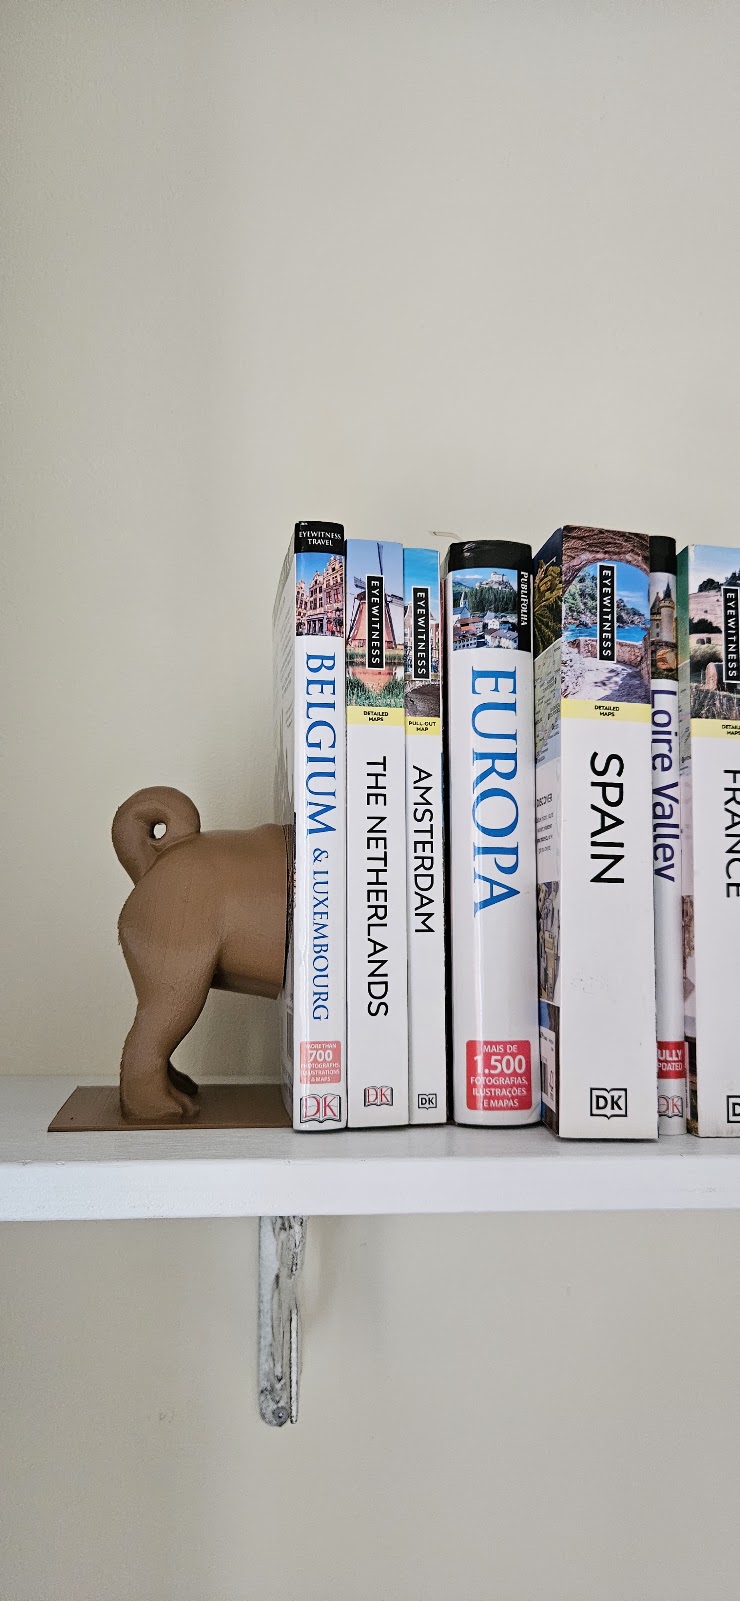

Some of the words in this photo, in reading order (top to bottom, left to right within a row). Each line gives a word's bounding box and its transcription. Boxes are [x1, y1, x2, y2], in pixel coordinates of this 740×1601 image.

[299, 531, 341, 539] EYEWITNESS
[520, 571, 529, 626] PUBLIFOLHA
[371, 581, 380, 664] EYEWITNESS
[603, 570, 611, 656] EYEWITNESS
[417, 592, 426, 675] EYEWITNESS
[726, 592, 737, 677] EYEWITNESS
[651, 690, 677, 772] Loire
[305, 652, 336, 836] BELGIUM
[366, 755, 387, 807] THE
[471, 666, 520, 918] EUROPA
[589, 751, 625, 884] SPAIN
[312, 848, 329, 862] &
[412, 764, 436, 933] AMSTERDAM
[366, 816, 389, 1017] NETHERLANDS
[312, 871, 329, 1021] LUXEMBOURG
[309, 1050, 333, 1062] 700
[483, 1045, 504, 1053] MAIS
[507, 1045, 518, 1053] DE
[658, 1049, 683, 1061] ULLY
[474, 1055, 526, 1074] 1.500
[658, 1062, 683, 1071] PDATED
[470, 1077, 528, 1085] FOTOGRAFIAS,
[472, 1087, 527, 1097] ILUSTRAÇÕES
[304, 1095, 337, 1119] DK
[366, 1087, 391, 1104] DK
[420, 1096, 435, 1106] DK
[484, 1099, 489, 1107] E
[490, 1099, 519, 1107] MAPAS
[594, 1094, 623, 1111] DK
